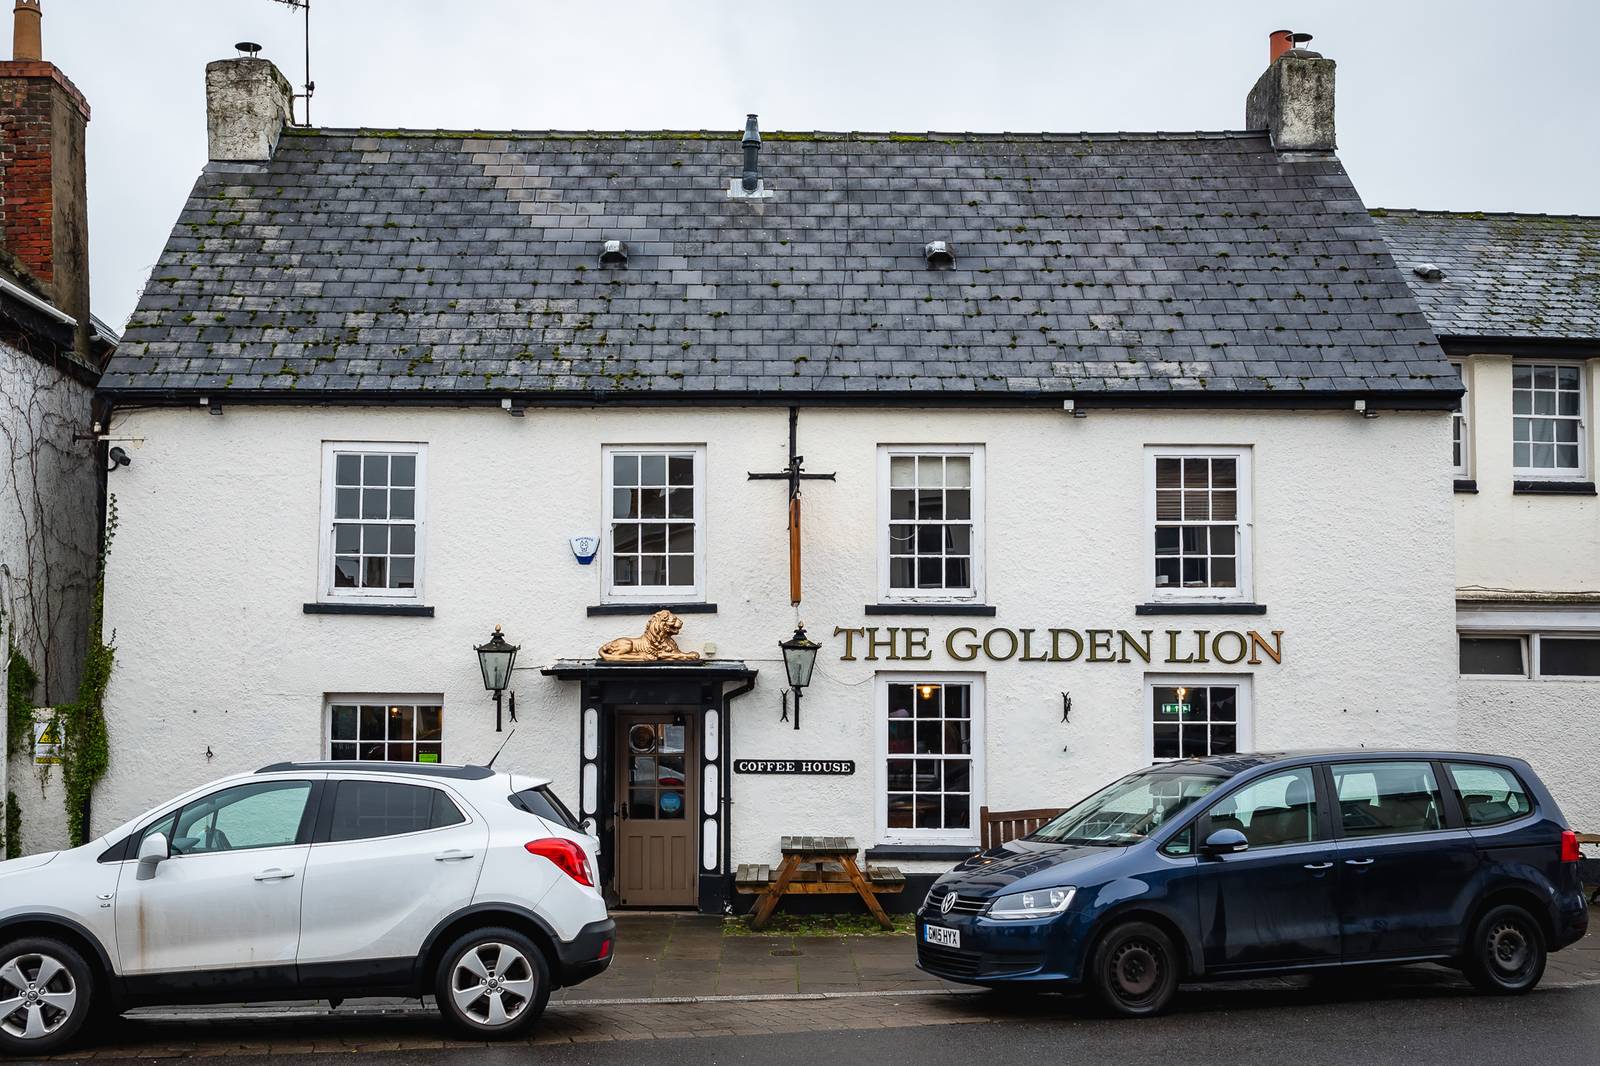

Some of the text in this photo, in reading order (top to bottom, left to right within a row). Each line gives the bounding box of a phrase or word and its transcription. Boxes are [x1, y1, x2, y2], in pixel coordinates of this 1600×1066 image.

[834, 626, 1284, 664] THE GOLDEN LION
[738, 761, 851, 773] COFFEE HOUSE
